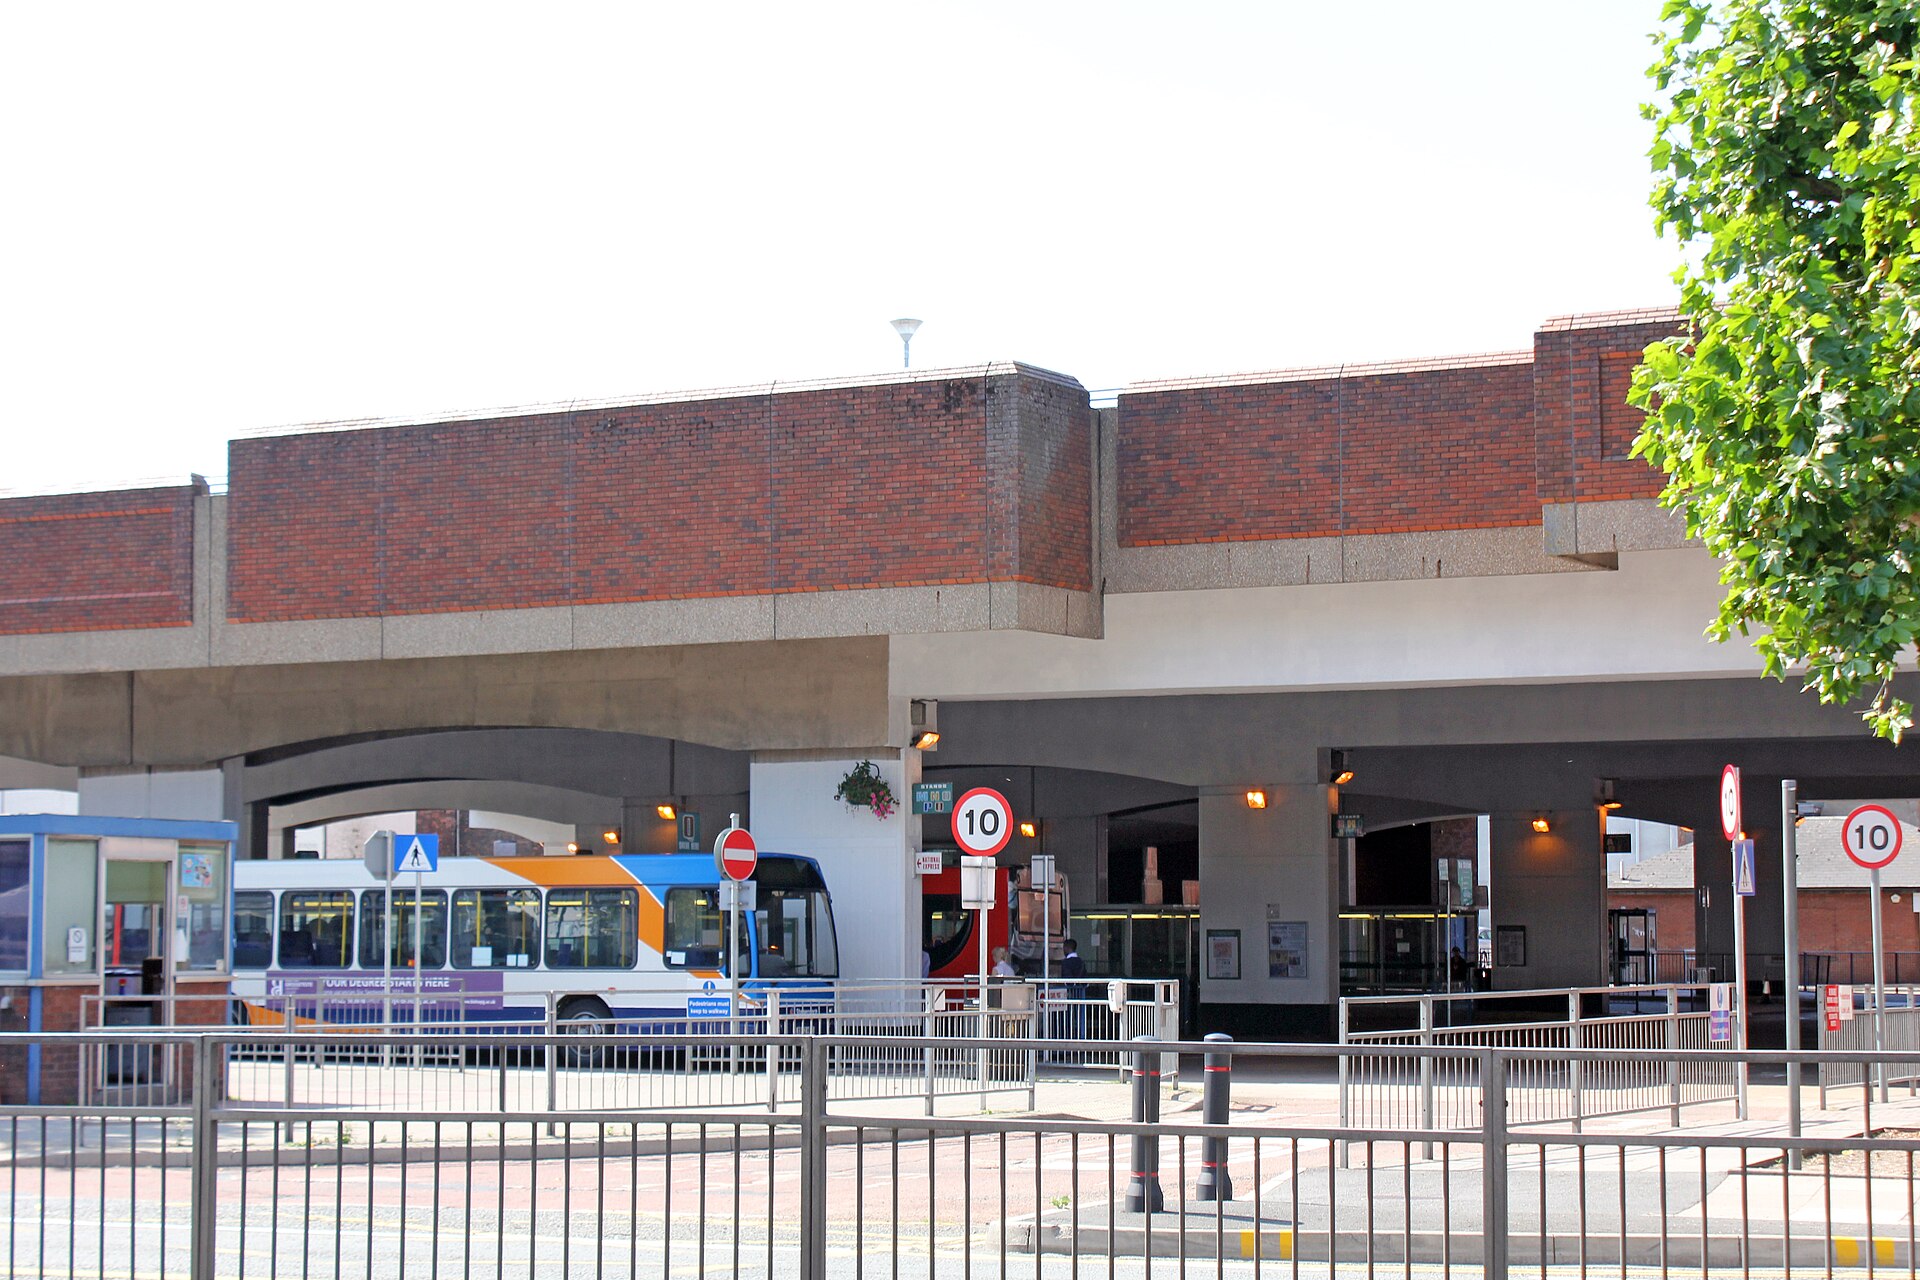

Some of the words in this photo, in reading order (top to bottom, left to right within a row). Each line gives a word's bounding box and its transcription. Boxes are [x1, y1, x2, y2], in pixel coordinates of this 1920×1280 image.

[930, 791, 940, 802] N
[923, 801, 933, 813] P
[965, 809, 1000, 836] 10
[1855, 825, 1889, 850] 10
[321, 977, 347, 988] OUR
